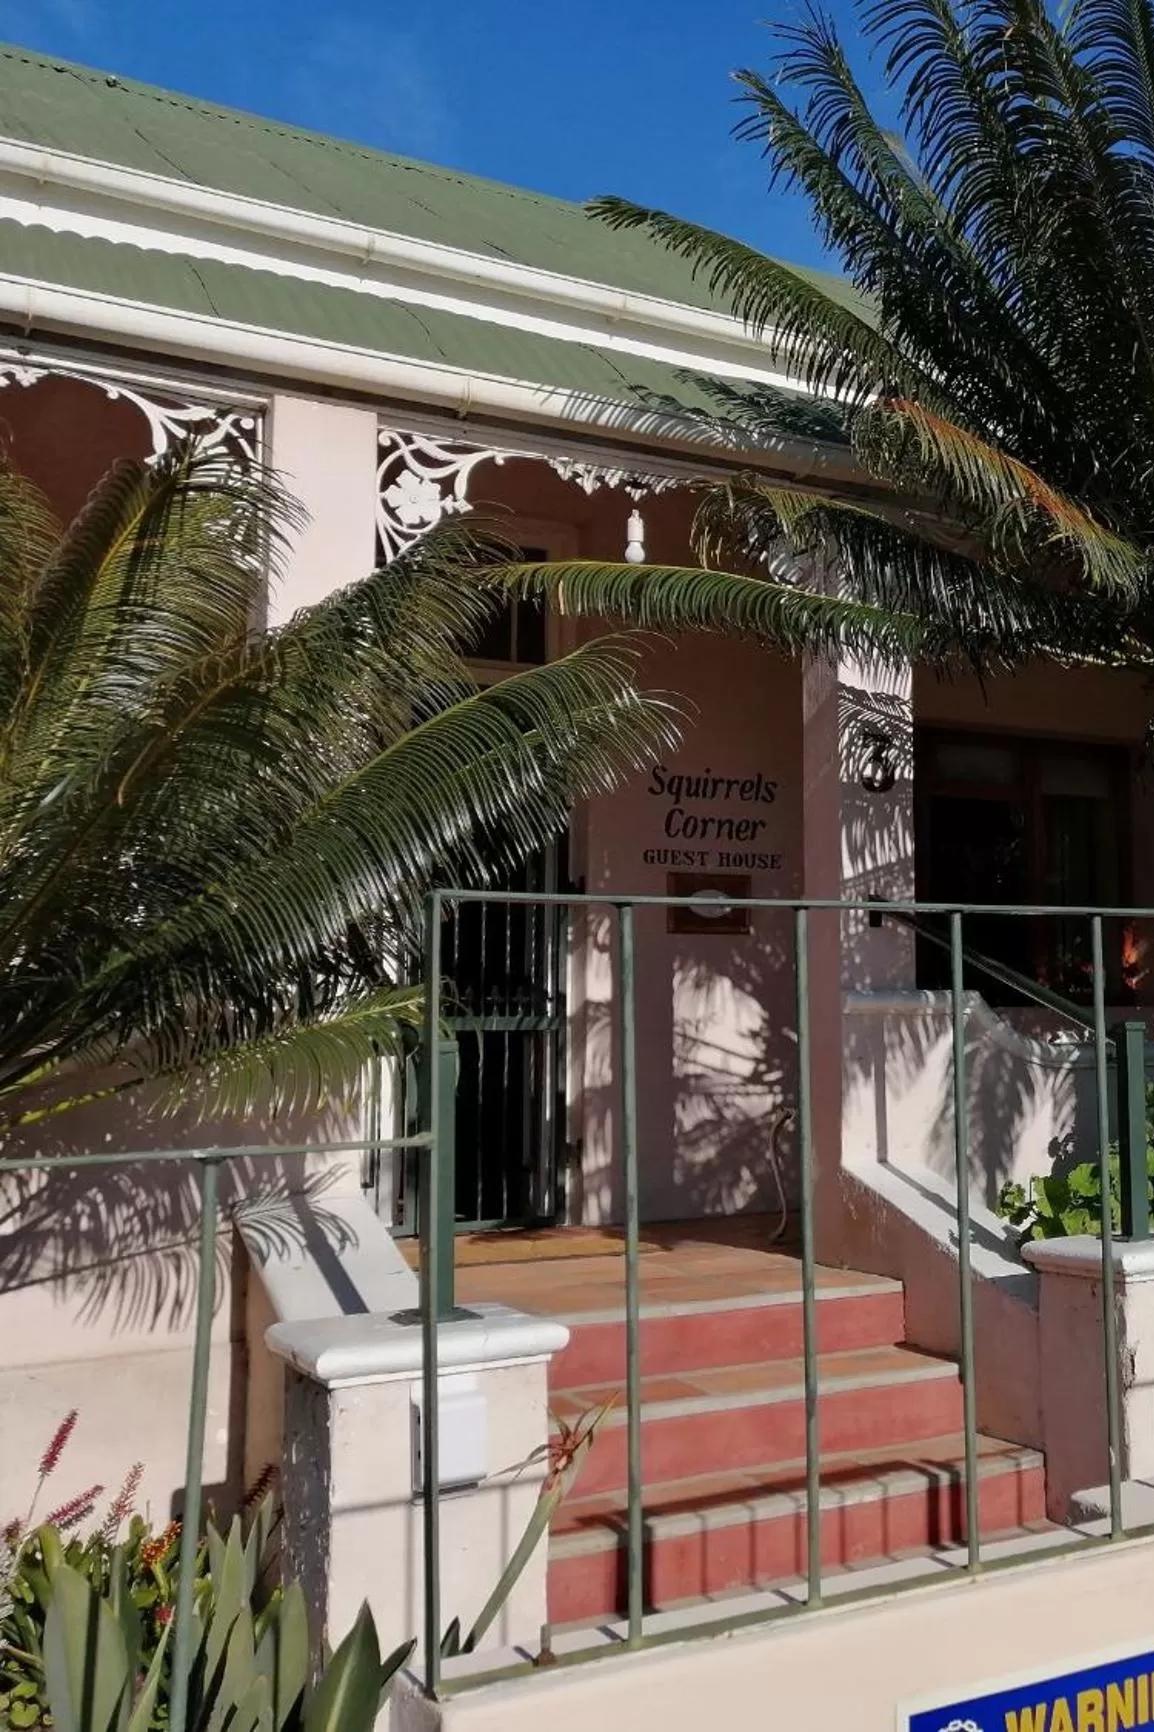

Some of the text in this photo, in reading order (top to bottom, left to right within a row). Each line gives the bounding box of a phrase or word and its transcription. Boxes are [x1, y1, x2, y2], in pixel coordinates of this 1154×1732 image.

[862, 732, 896, 793] 3
[648, 764, 778, 804] Squirrels
[664, 807, 767, 841] Corner
[643, 849, 782, 870] GUEST HOUSE
